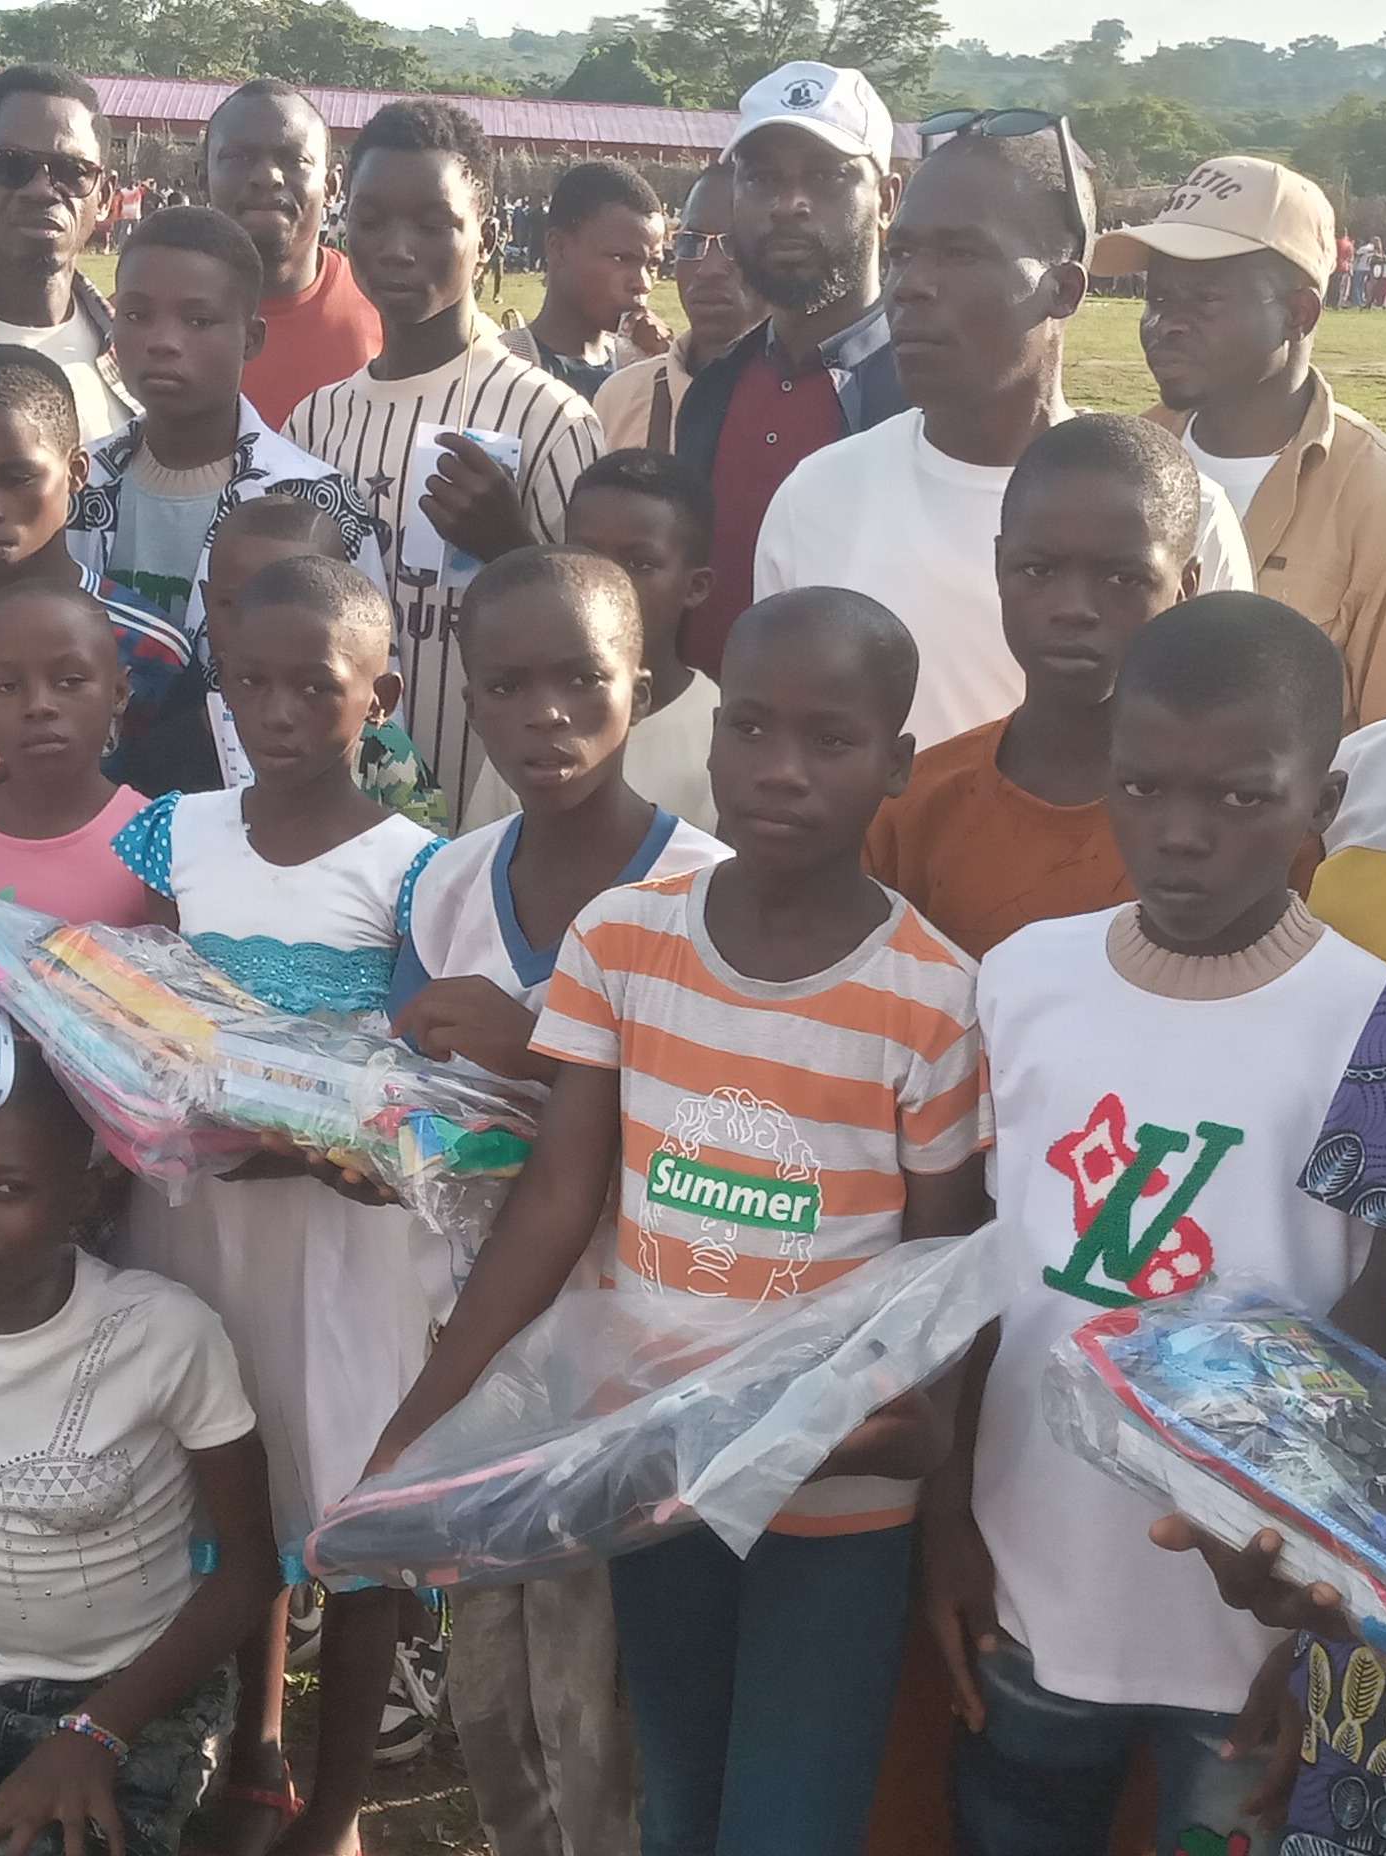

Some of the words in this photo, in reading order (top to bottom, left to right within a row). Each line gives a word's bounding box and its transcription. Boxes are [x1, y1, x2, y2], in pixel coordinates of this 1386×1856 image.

[1177, 168, 1243, 201] ETIC
[393, 600, 461, 642] UR
[651, 1158, 812, 1224] Summer
